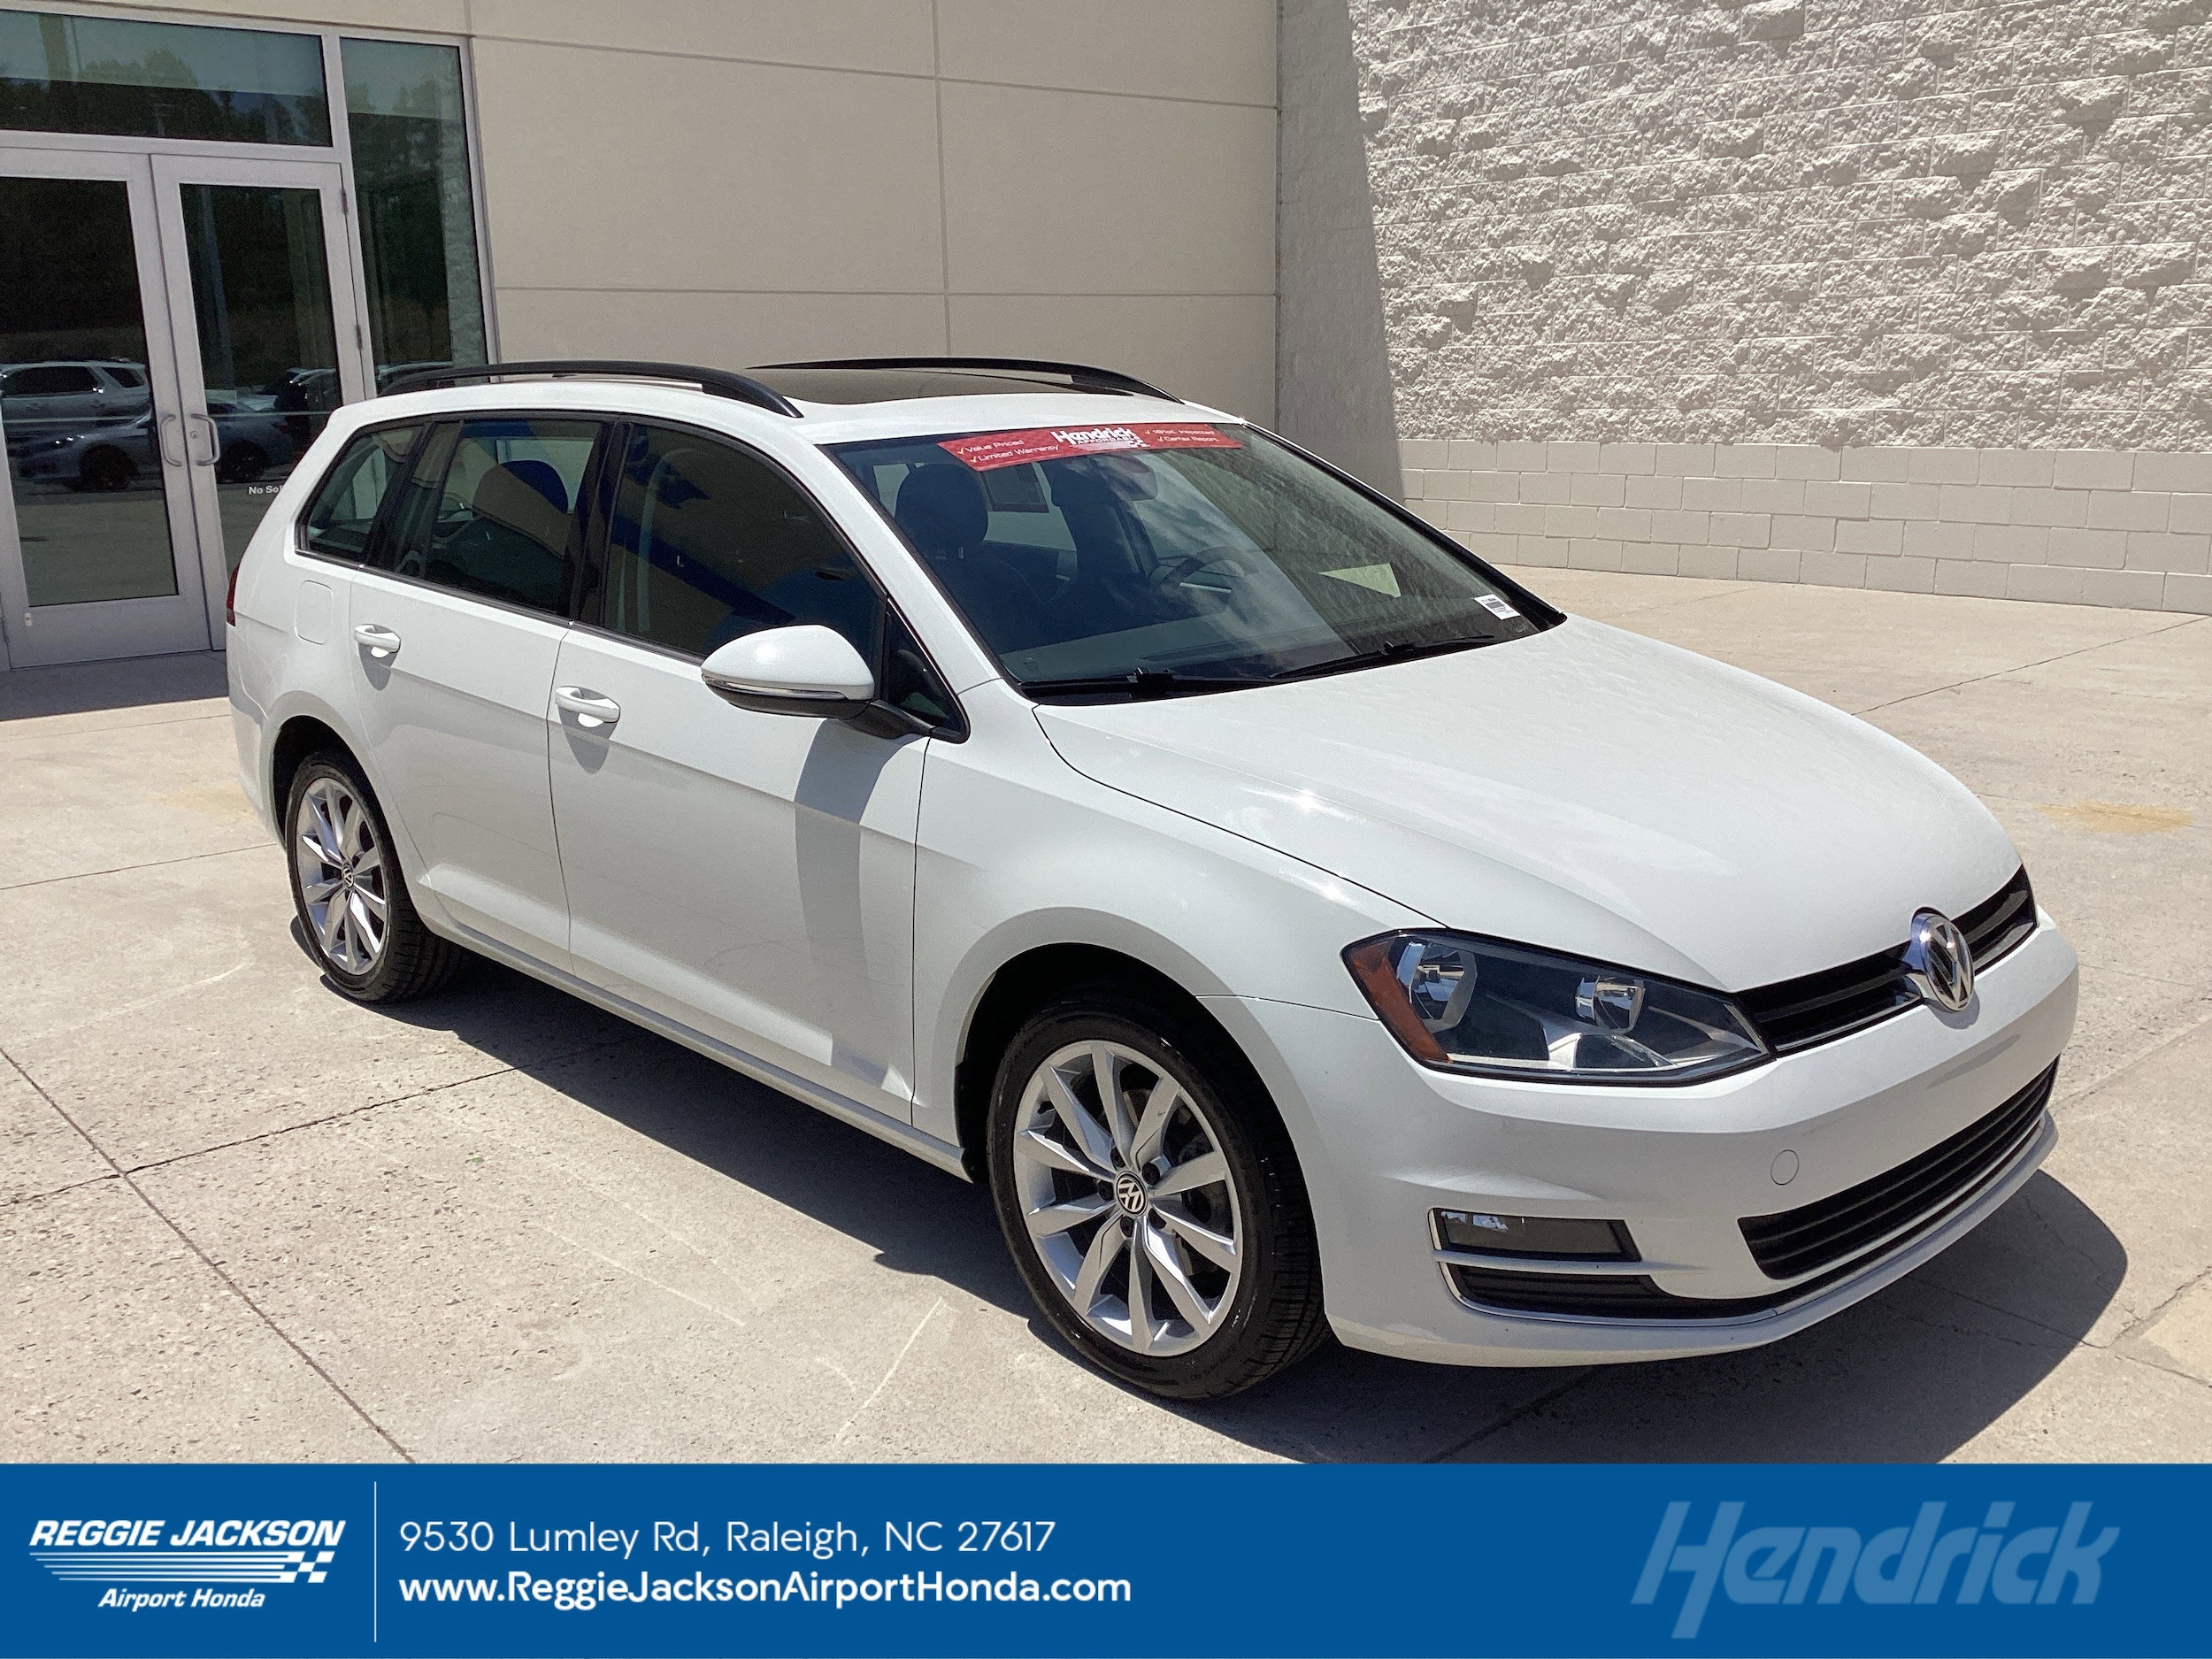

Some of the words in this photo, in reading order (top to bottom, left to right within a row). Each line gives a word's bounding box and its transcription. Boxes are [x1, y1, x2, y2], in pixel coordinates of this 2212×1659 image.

[1049, 426, 1137, 445] Hendrick
[993, 440, 1025, 449] Priced
[978, 450, 1014, 461] Limited
[1015, 444, 1059, 456] Warranty
[248, 486, 264, 495] No
